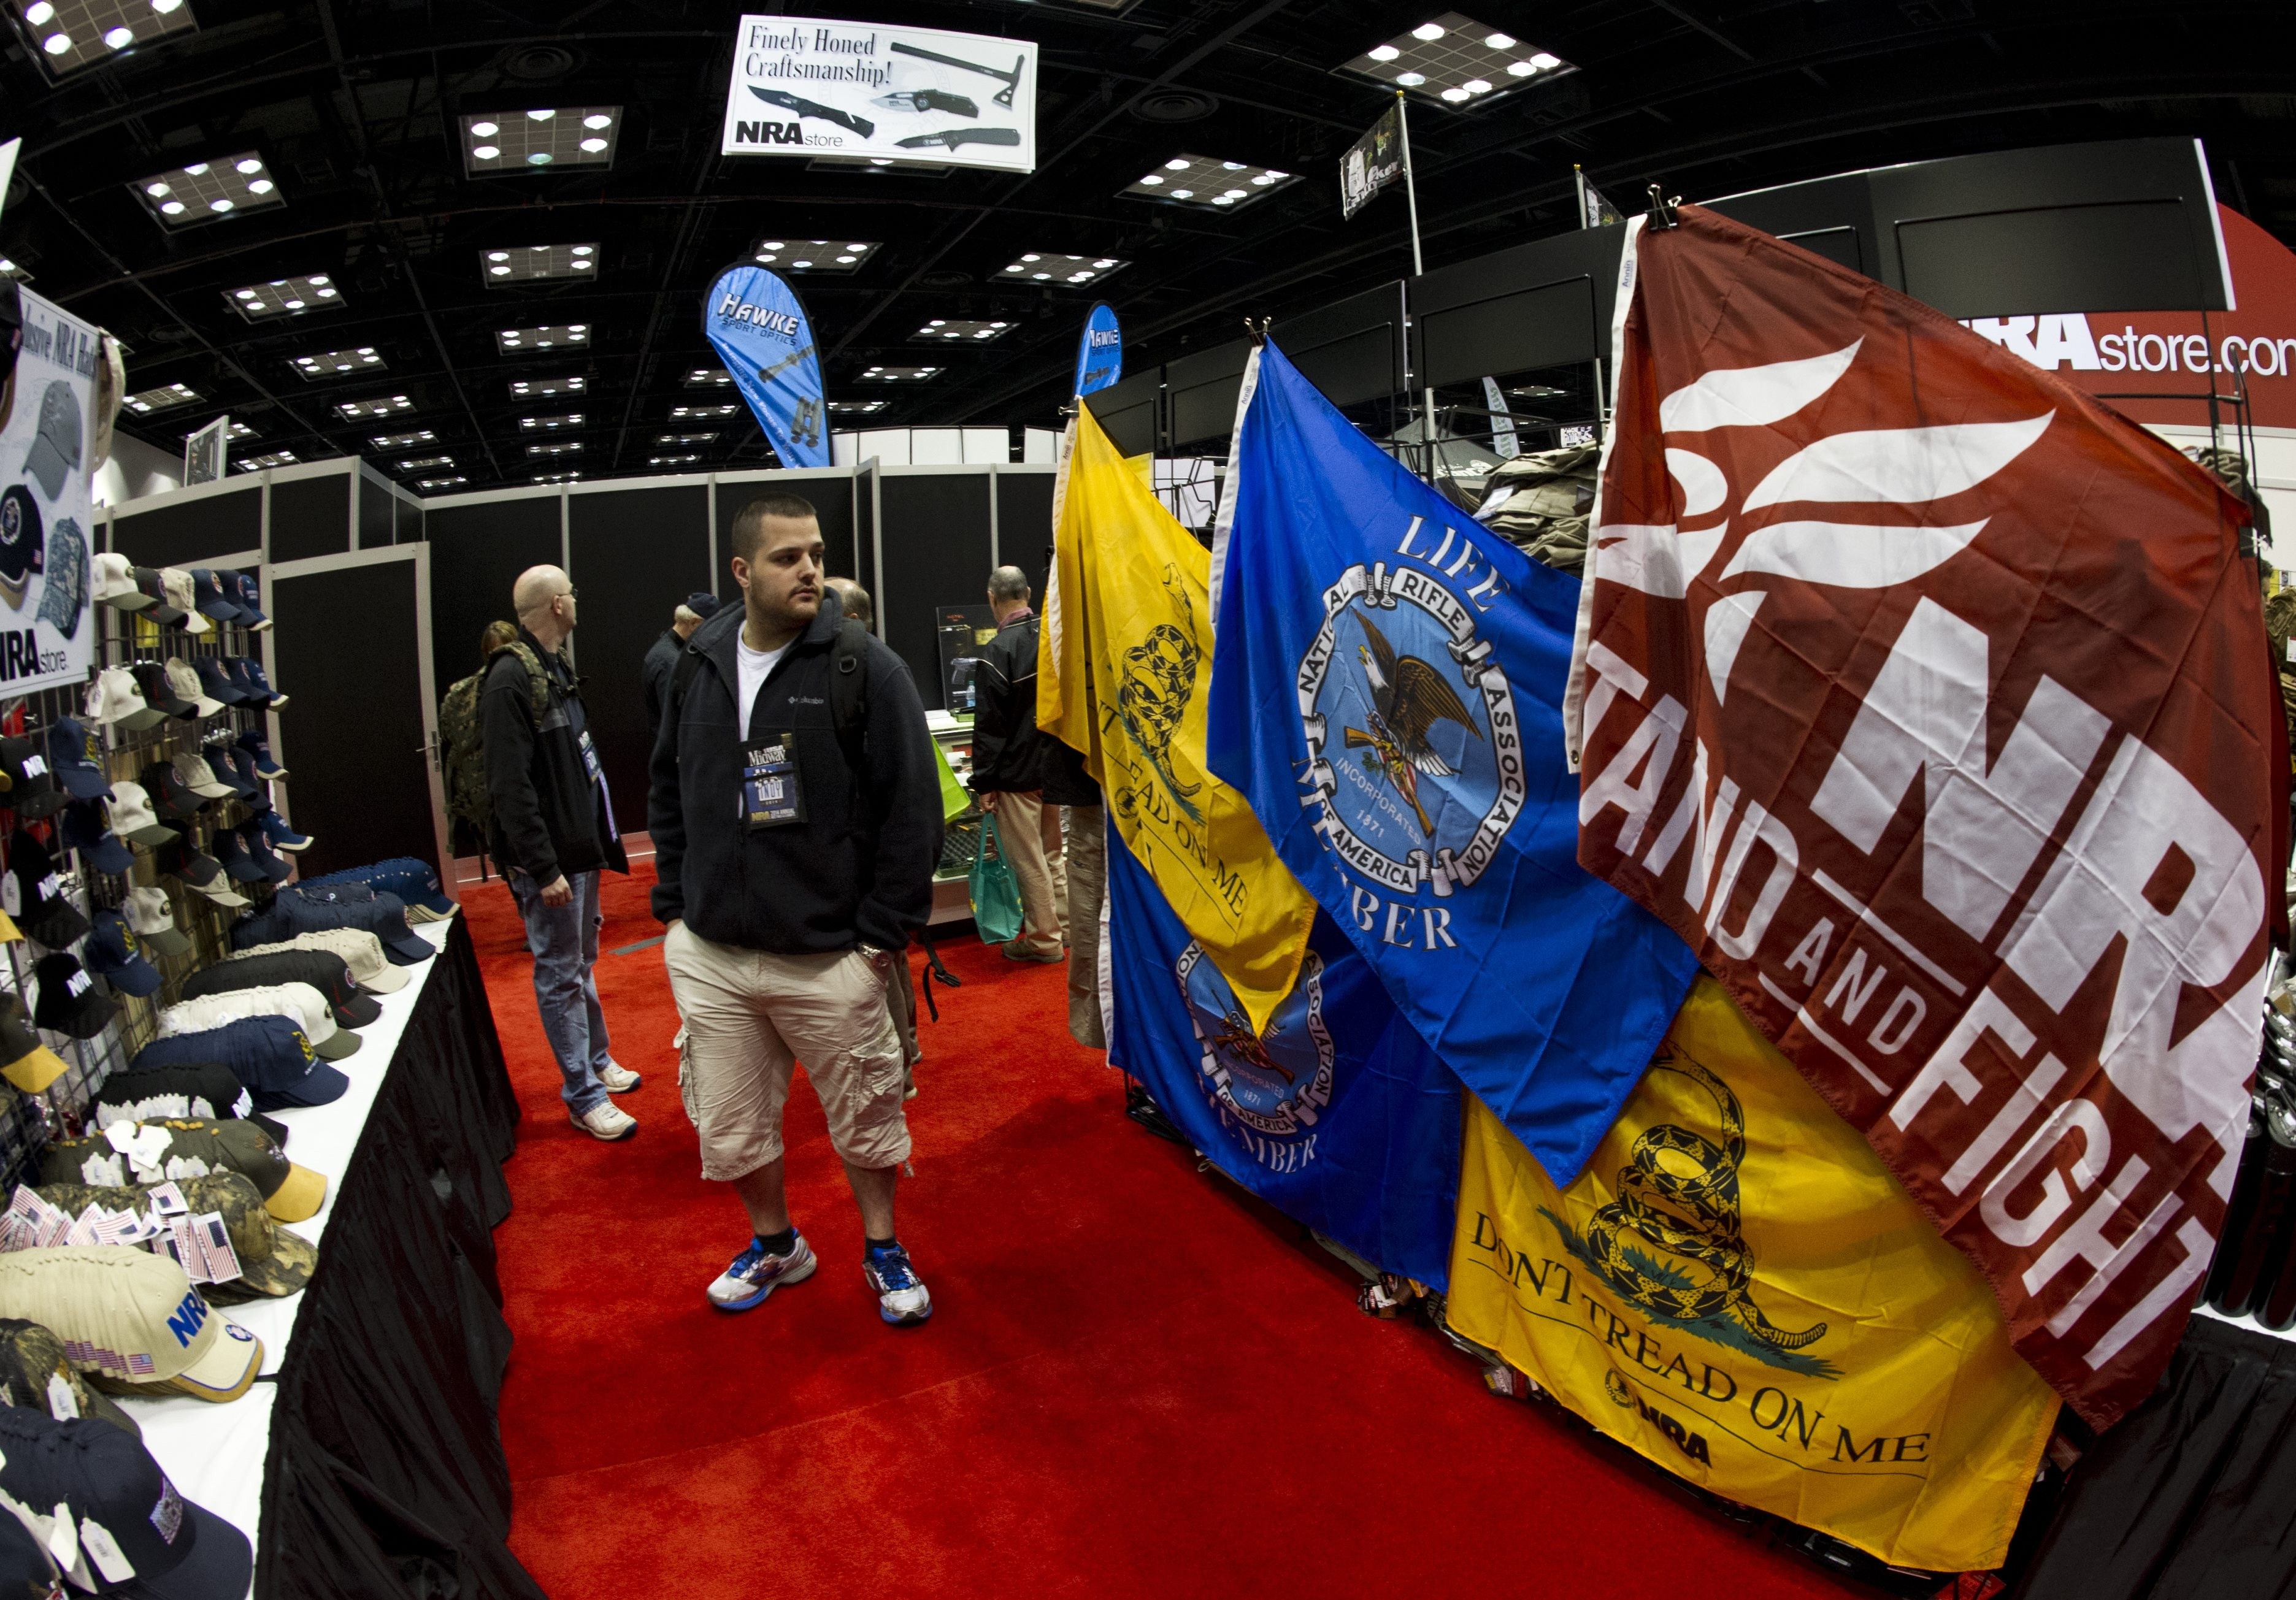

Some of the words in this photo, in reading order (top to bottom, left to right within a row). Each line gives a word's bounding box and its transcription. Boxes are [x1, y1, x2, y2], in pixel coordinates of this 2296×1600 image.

[745, 53, 893, 87] Craftsmanship!
[748, 25, 808, 55] Finely
[814, 28, 877, 56] Honed
[718, 293, 799, 335] HAWKE
[721, 317, 757, 337] SPORT
[760, 327, 797, 347] OPTICS
[1958, 313, 2296, 376] RAstore.co
[1394, 514, 1510, 613] LIFE
[1401, 573, 1465, 632] RIFLE
[1462, 686, 1522, 878] ASSOCIATION
[1335, 757, 1422, 846] INCORPORATED
[1355, 809, 1386, 839] 1871
[1212, 856, 1248, 917] ME
[1332, 829, 1414, 888] AMERICA
[1809, 594, 2268, 1203] NR
[1783, 917, 1927, 1057] AND
[1238, 1108, 1296, 1131] AMERICA
[1243, 1090, 1261, 1105] 1871
[1889, 985, 2217, 1371] FIGHT
[166, 1283, 209, 1349] NR
[1582, 1293, 1738, 1403] TREAD
[1750, 1387, 1825, 1450] ON
[1829, 1424, 1932, 1464] ME
[1637, 1396, 1713, 1469] NRA
